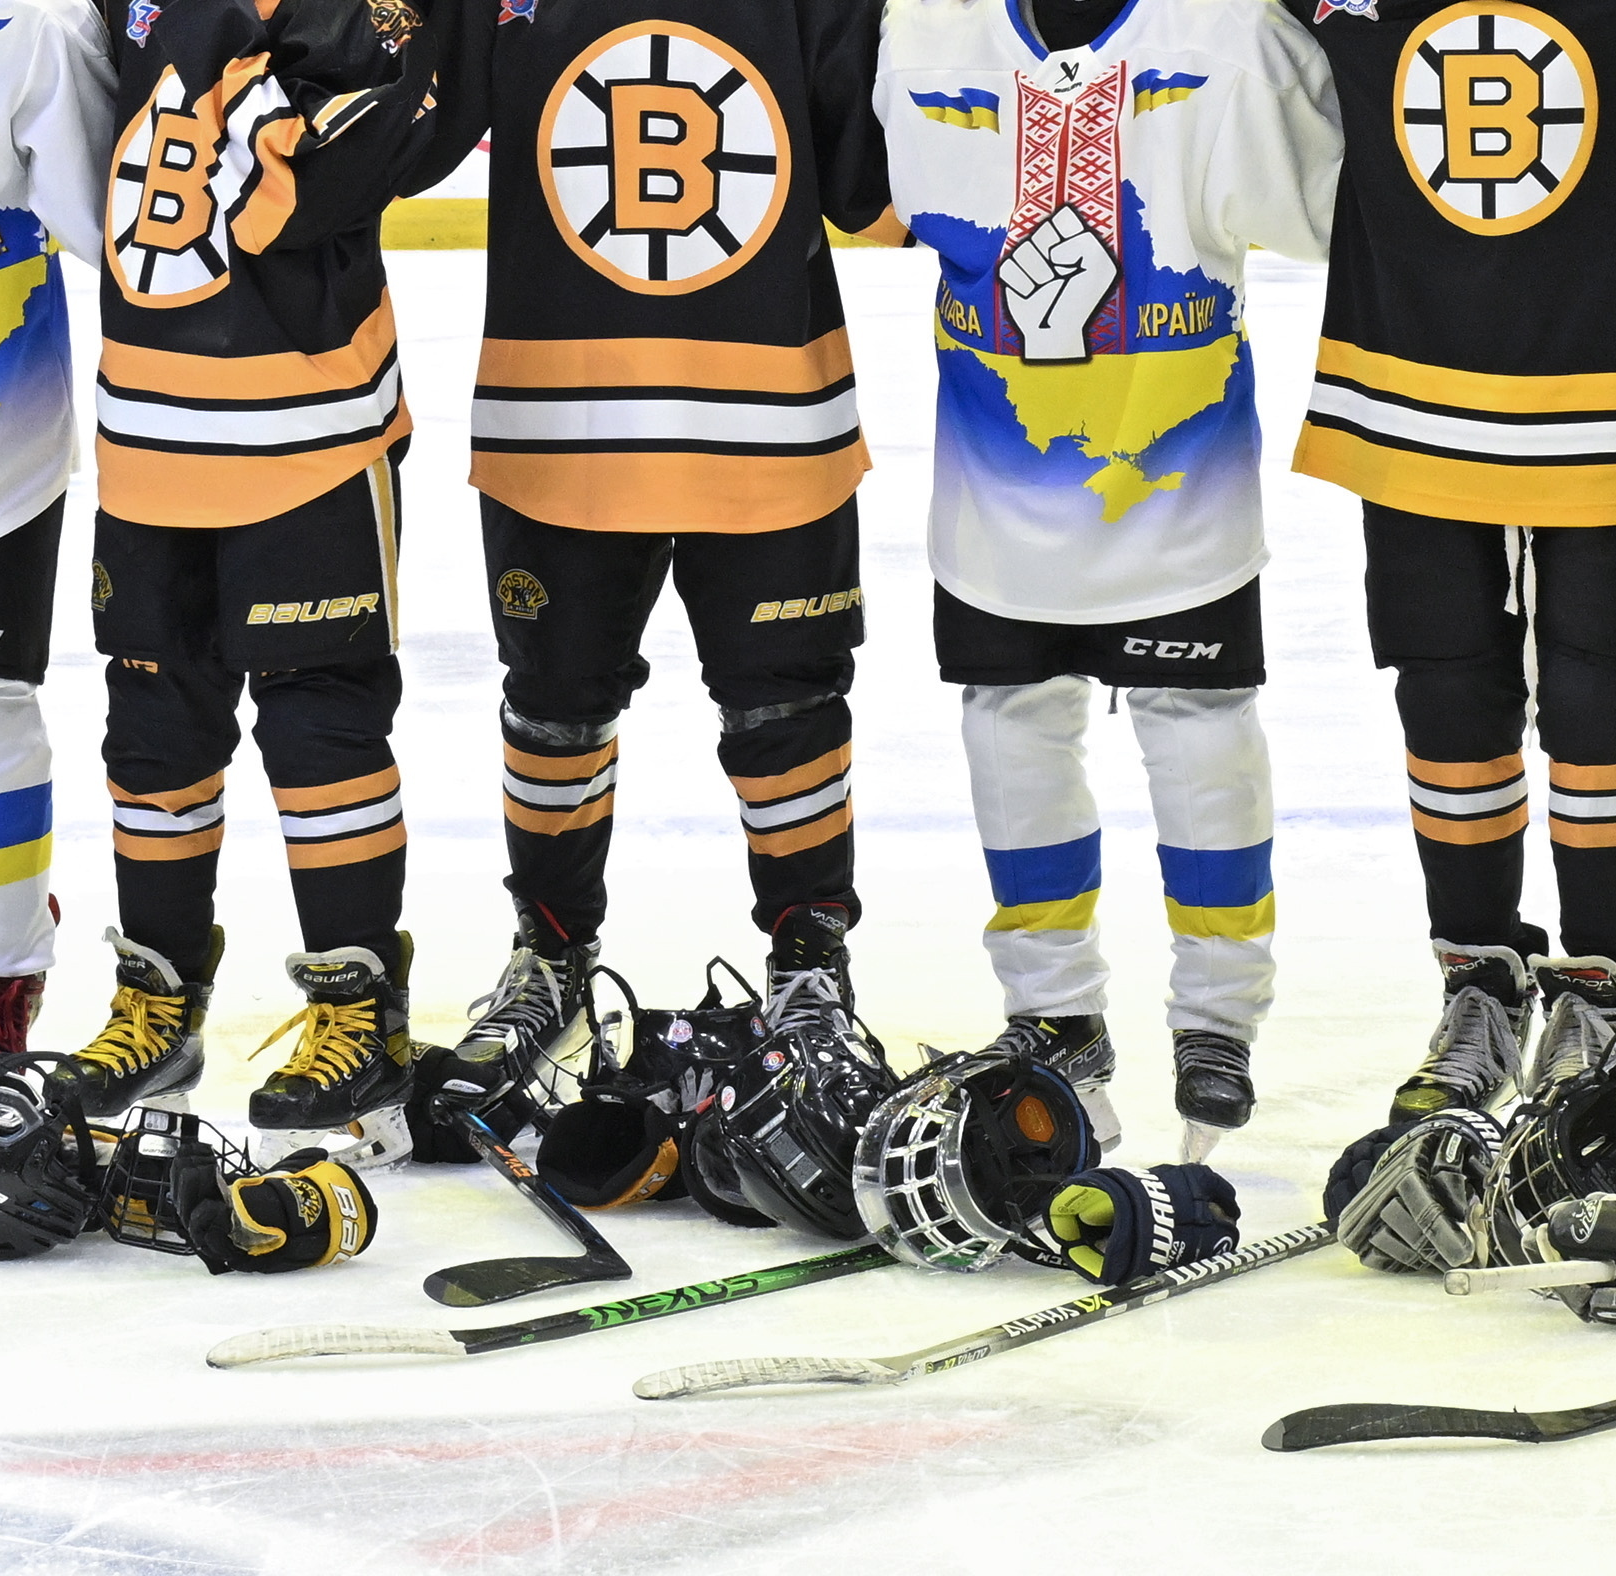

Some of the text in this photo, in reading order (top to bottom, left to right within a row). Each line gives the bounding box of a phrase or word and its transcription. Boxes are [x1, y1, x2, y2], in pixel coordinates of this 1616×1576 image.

[1054, 81, 1083, 94] BAUER
[1444, 54, 1539, 180] B
[612, 84, 719, 232] B
[133, 110, 216, 250] B
[499, 572, 545, 605] BOSTON
[751, 586, 863, 623] BAUER
[247, 592, 380, 625] BAUER
[1124, 636, 1223, 661] CCM
[303, 970, 359, 984] BAUER
[1001, 1303, 1081, 1338] ALPHA
[1163, 1223, 1333, 1286] WARRIOR
[580, 1276, 759, 1330] NEXUS
